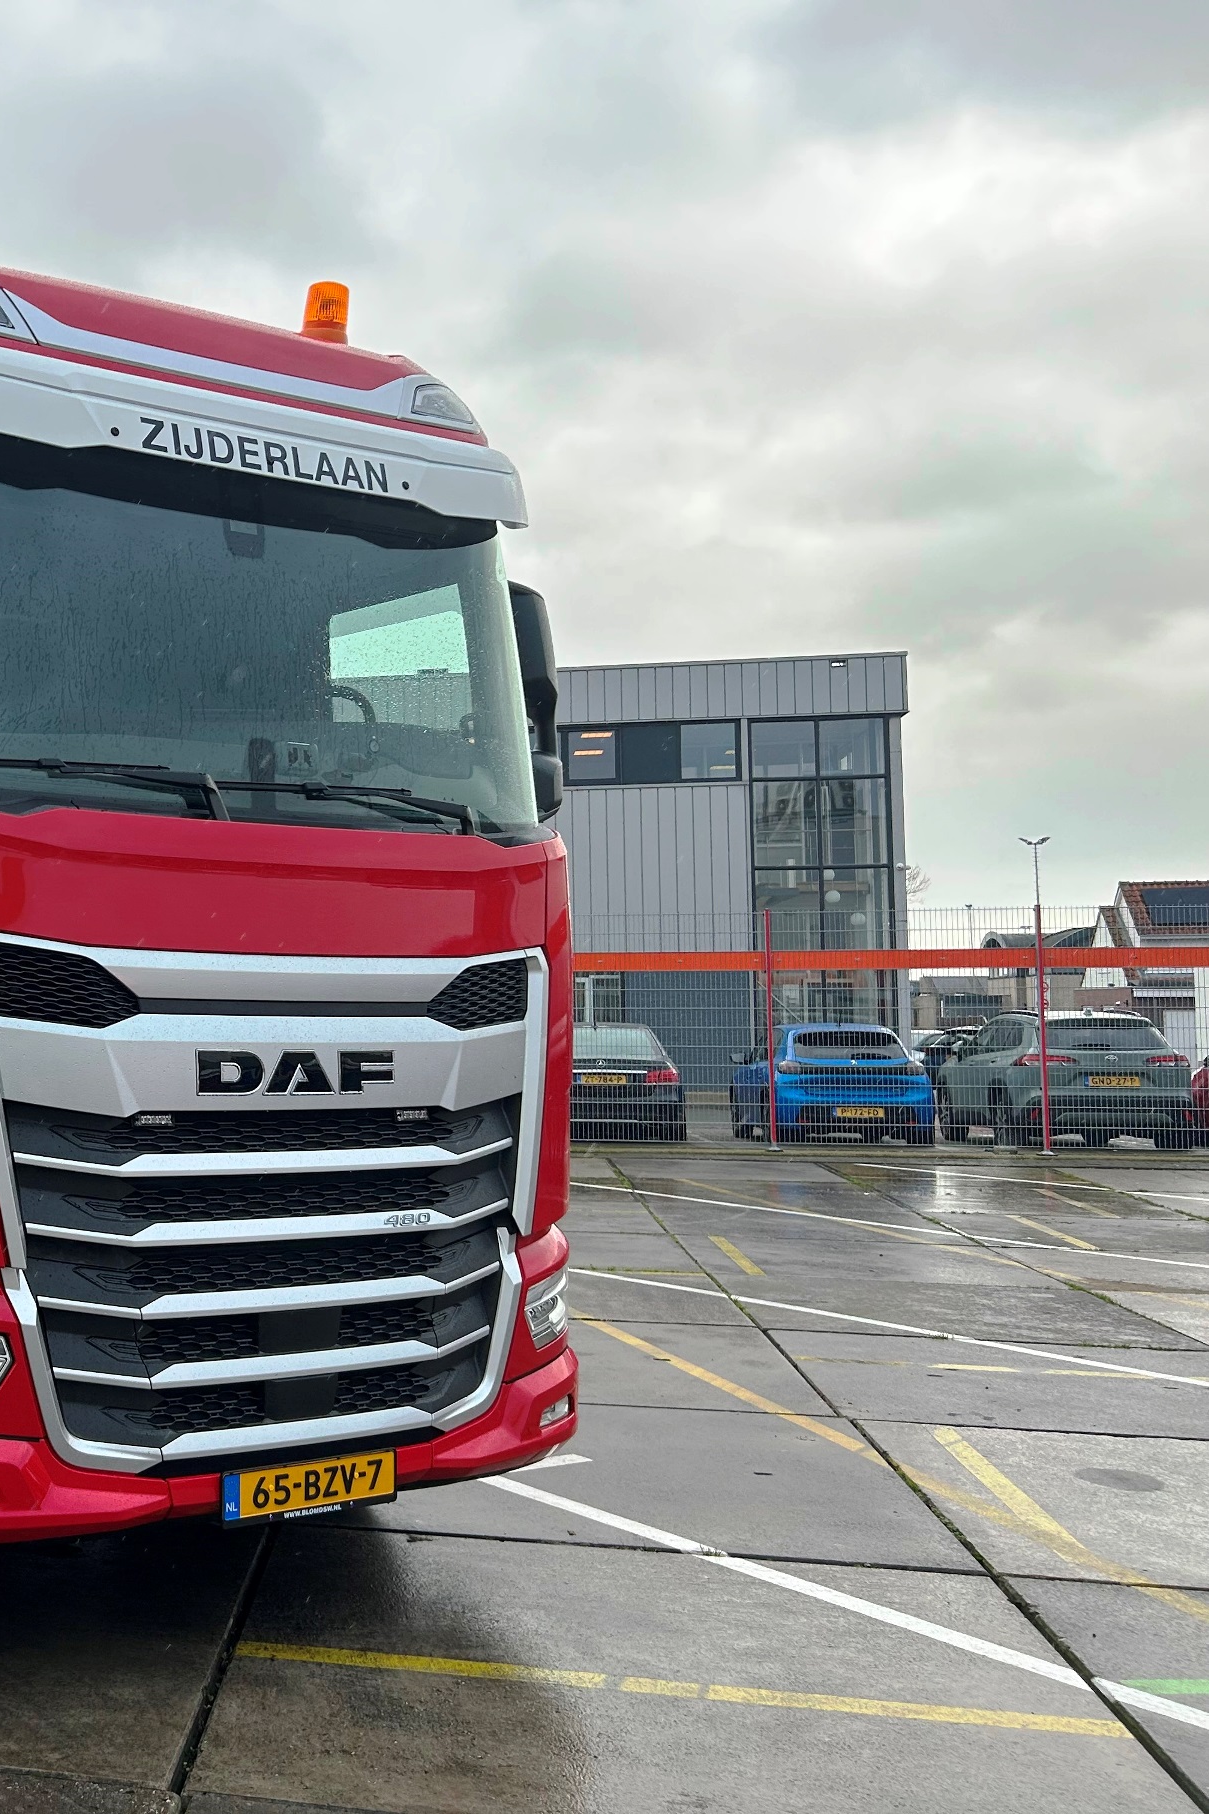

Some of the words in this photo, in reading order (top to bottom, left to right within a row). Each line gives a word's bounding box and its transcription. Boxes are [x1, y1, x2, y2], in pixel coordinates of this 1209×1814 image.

[140, 416, 388, 493] ZIJDERLAAN
[194, 1047, 396, 1096] DAF
[383, 1212, 431, 1228] 480
[225, 1501, 238, 1513] NL
[252, 1458, 383, 1509] 65-BZV-7
